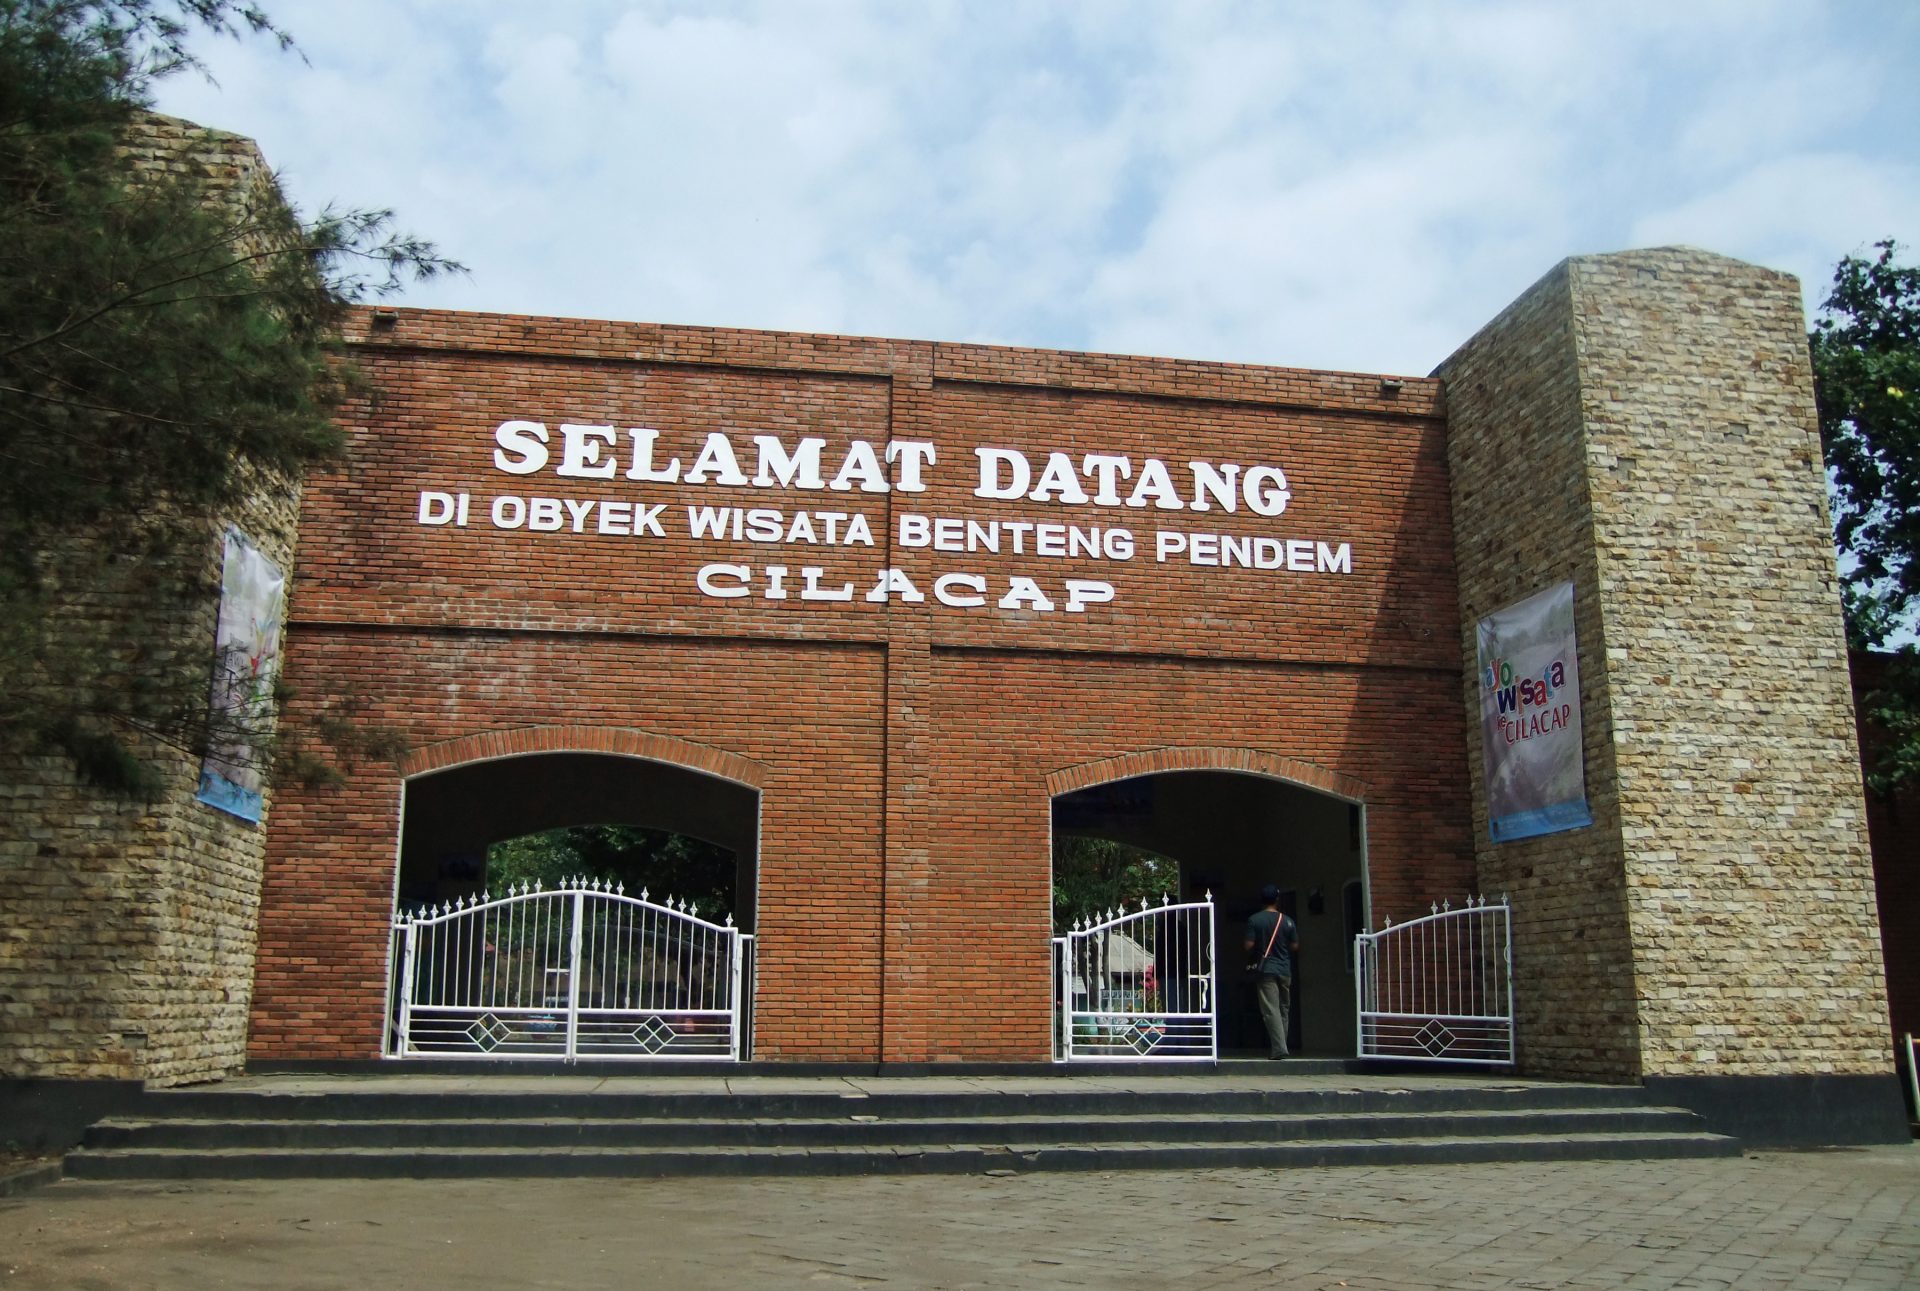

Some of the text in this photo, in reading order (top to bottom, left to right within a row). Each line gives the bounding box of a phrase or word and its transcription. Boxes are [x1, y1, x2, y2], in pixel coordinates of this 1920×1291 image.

[494, 420, 1290, 516] SELAMAT DATANG
[419, 491, 1351, 574] DI OBYEK WISATA BENTENG PENDEM
[697, 564, 1115, 612] CILACAP
[1486, 659, 1512, 692] ayo
[1498, 662, 1565, 714] wisata
[1505, 705, 1570, 742] CILACAP
